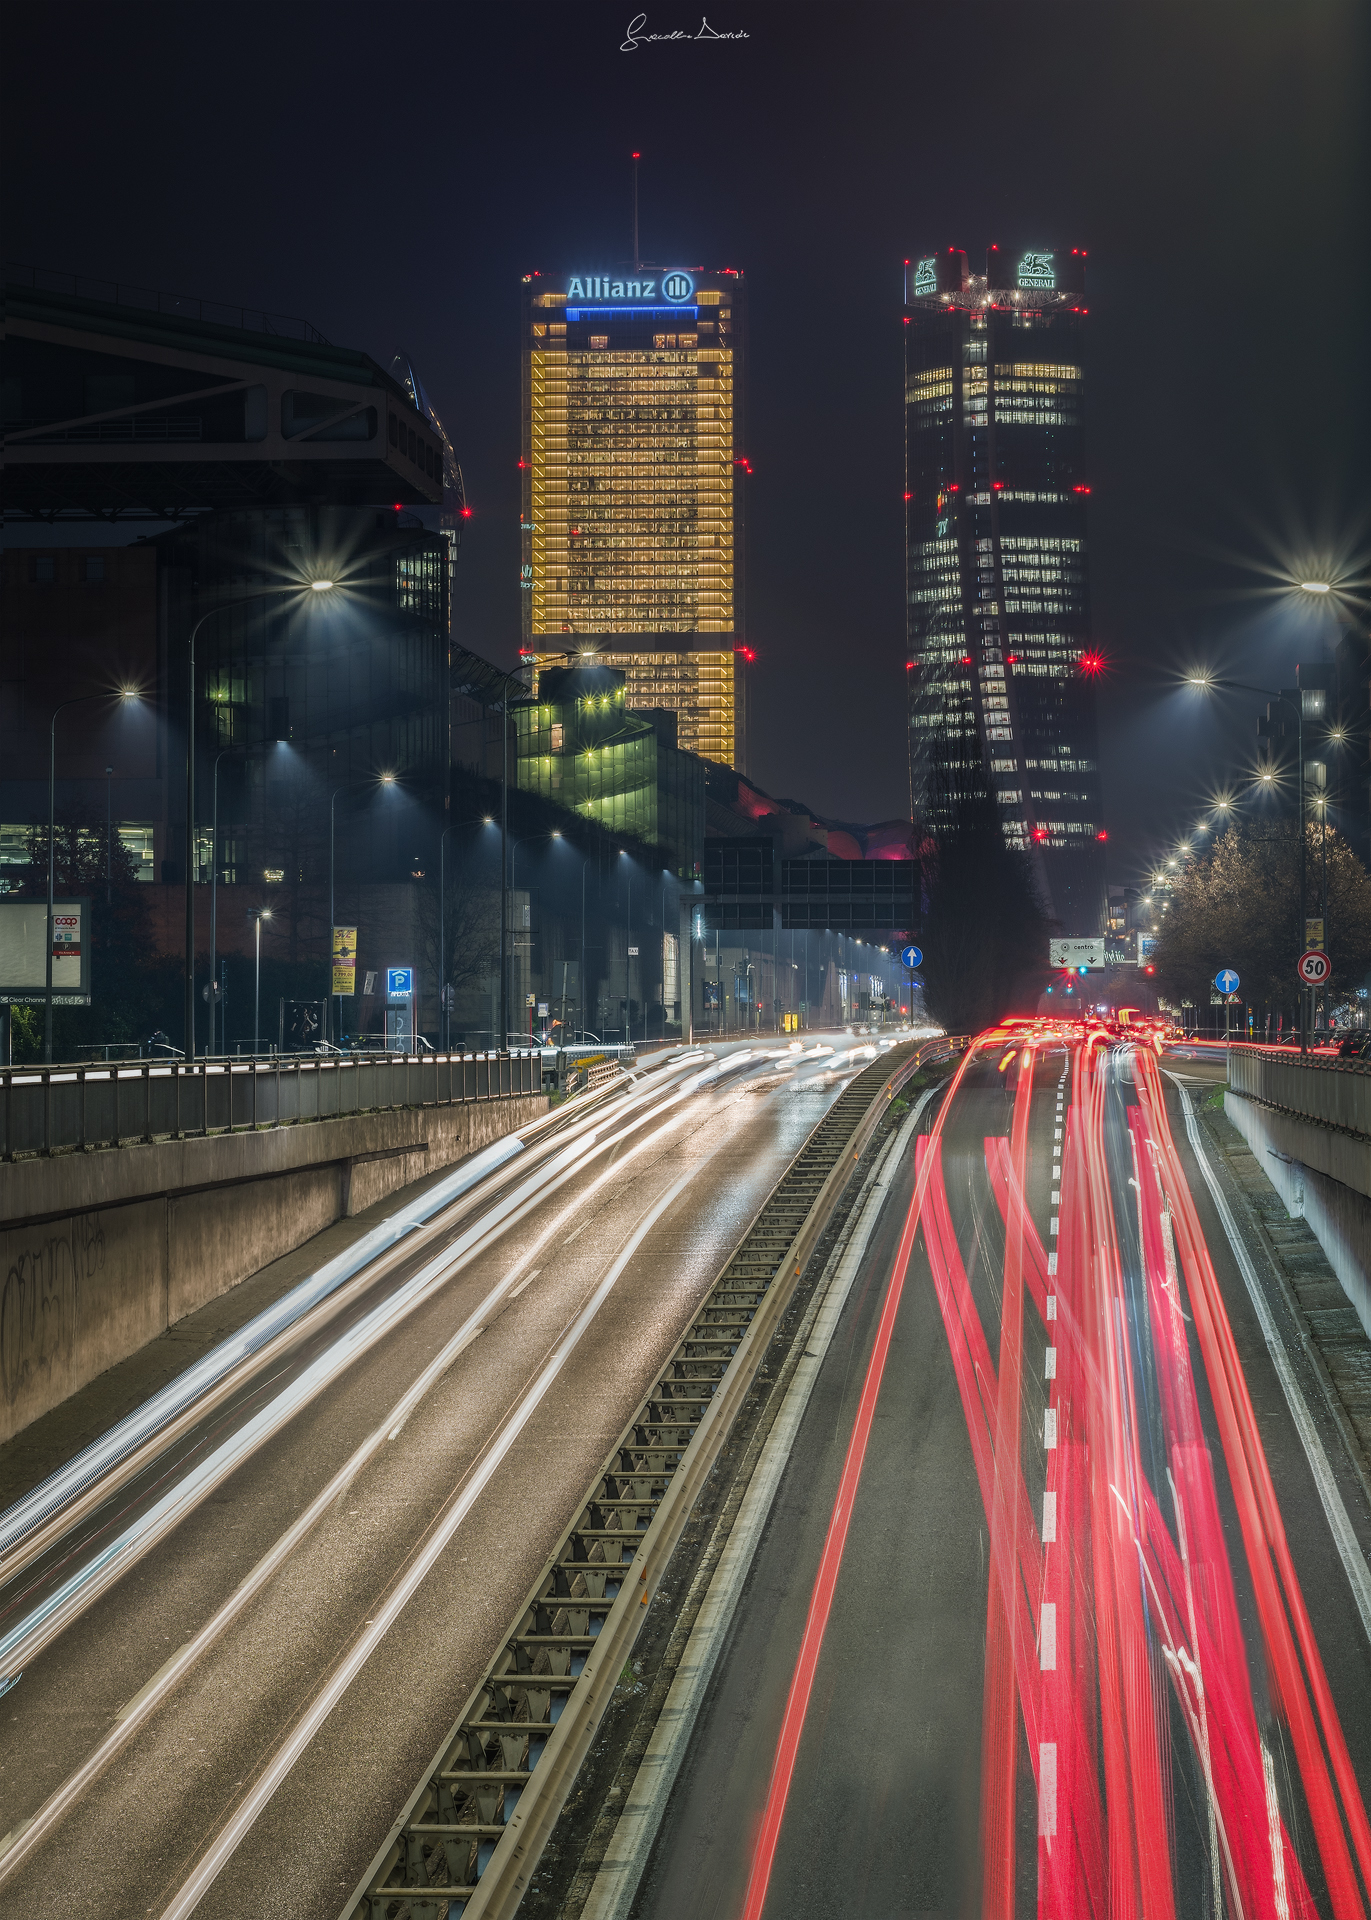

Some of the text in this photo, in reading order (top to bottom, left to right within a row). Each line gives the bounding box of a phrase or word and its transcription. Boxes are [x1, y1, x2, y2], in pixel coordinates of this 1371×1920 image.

[567, 277, 655, 298] Allianz
[1019, 277, 1055, 288] GENERALI
[916, 283, 937, 296] GENERALI
[55, 918, 77, 926] coop
[1304, 959, 1324, 976] 50
[395, 975, 405, 987] P
